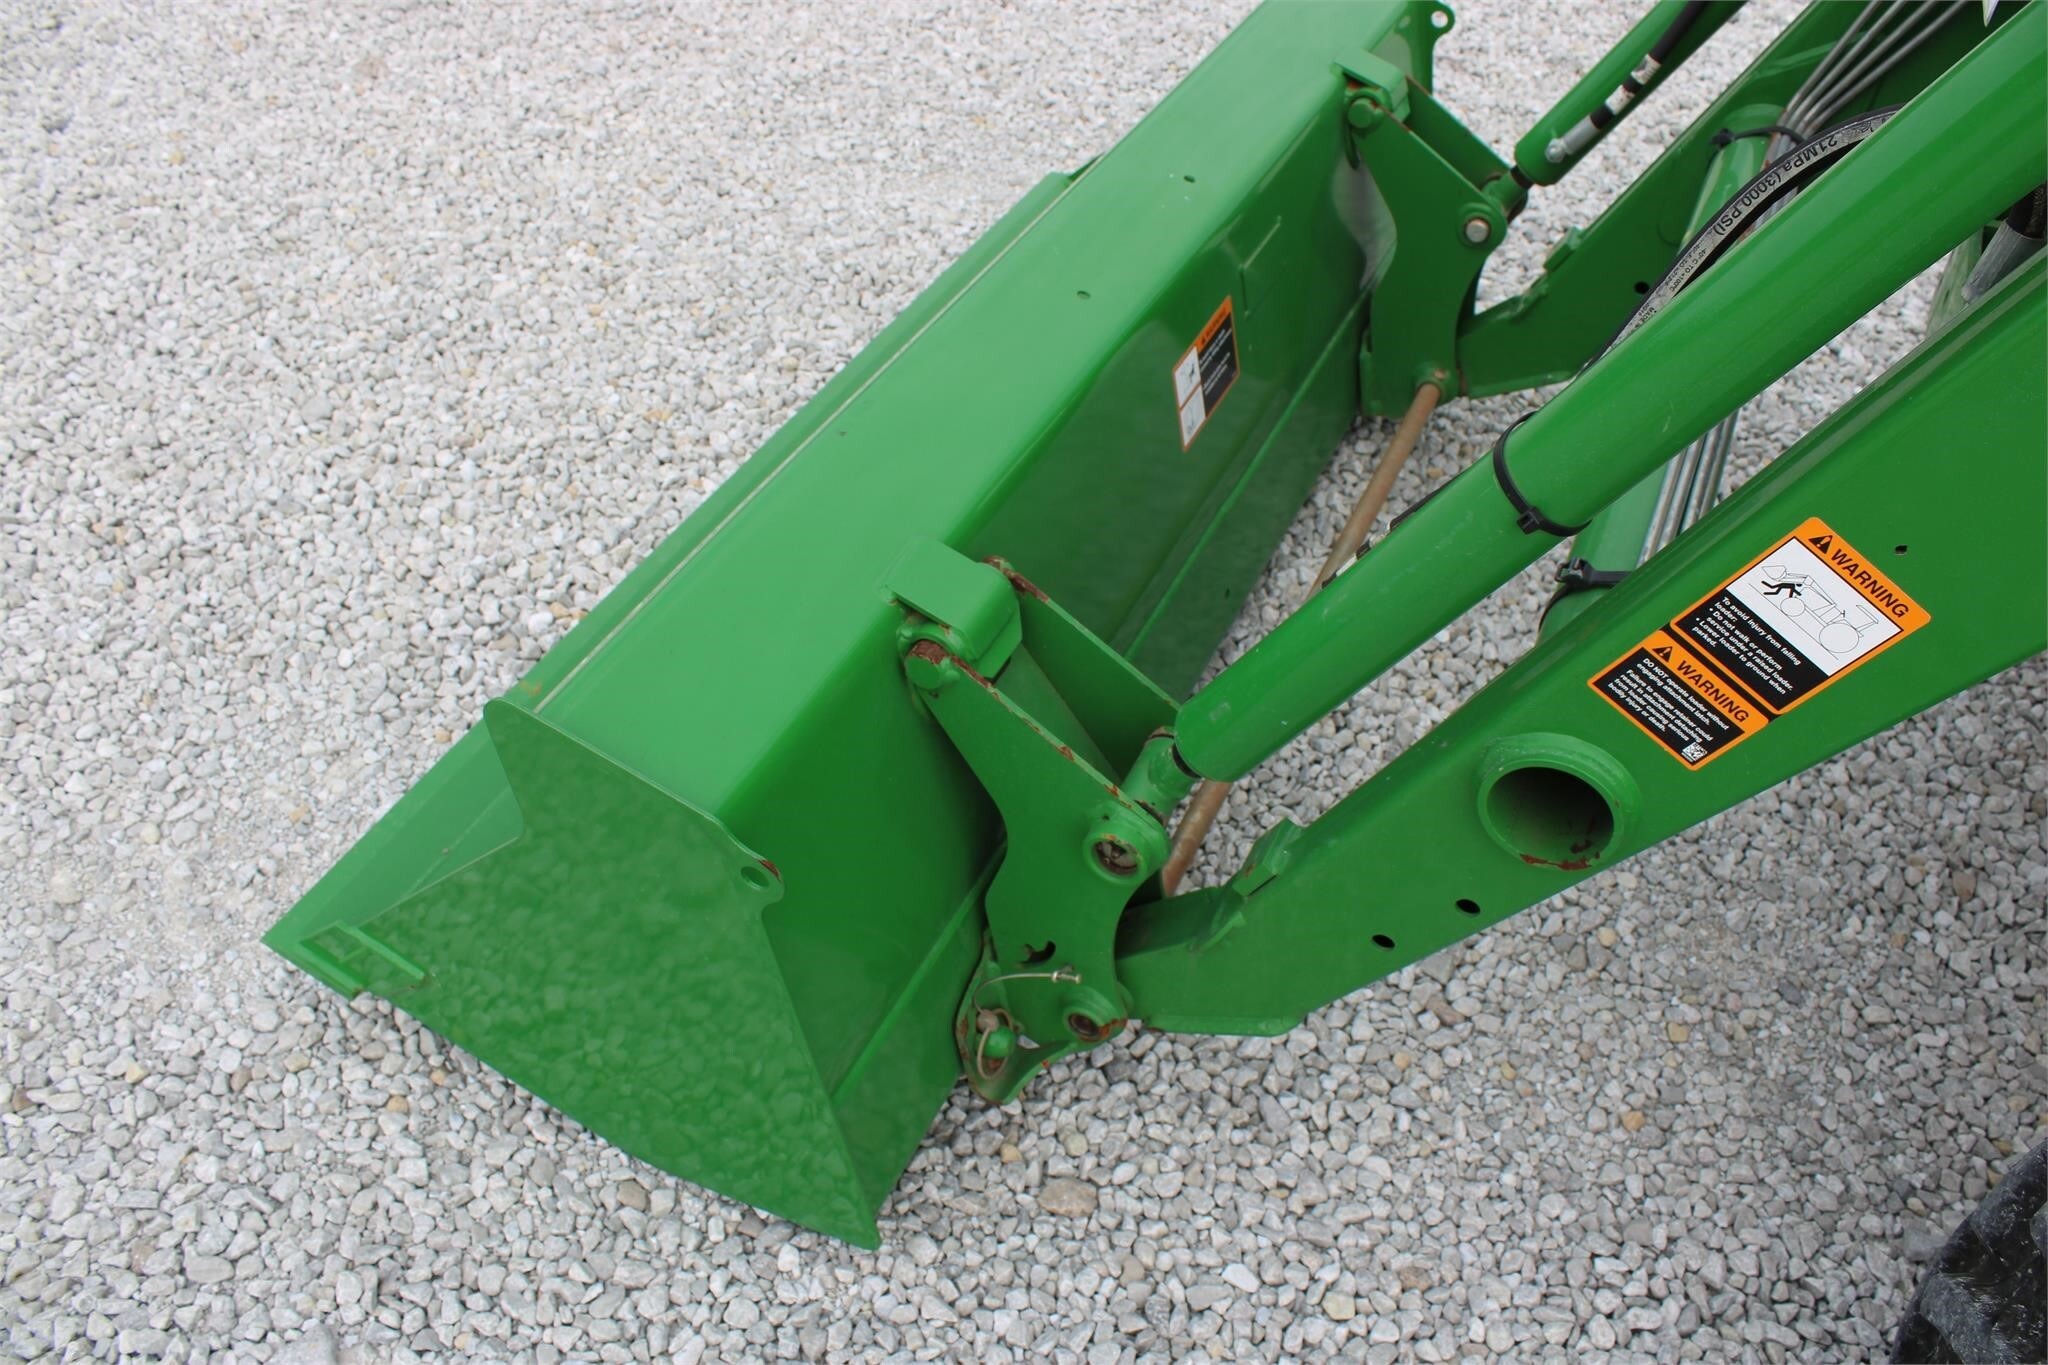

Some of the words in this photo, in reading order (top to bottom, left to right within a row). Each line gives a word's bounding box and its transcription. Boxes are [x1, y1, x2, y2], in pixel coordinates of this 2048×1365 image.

[1784, 136, 1838, 172] 21MPa
[1714, 207, 1742, 235] PSI)
[1742, 175, 1782, 207] (3000
[1715, 602, 1737, 621] loader:
[1831, 548, 1909, 619] WARNING
[1692, 626, 1717, 646] parked.
[1699, 621, 1720, 638] Lower
[1719, 637, 1740, 655] loader
[1745, 661, 1769, 680] ground
[1768, 679, 1785, 693] when
[1707, 616, 1730, 636] service
[1729, 636, 1748, 651] under
[1752, 655, 1773, 672] raised
[1773, 672, 1793, 689] loader.
[1713, 611, 1723, 619] Do
[1722, 619, 1734, 629] not
[1734, 629, 1750, 642] walk
[1755, 648, 1782, 670] perform
[1722, 597, 1731, 605] To
[1730, 604, 1748, 620] avoid
[1747, 619, 1766, 635] injury
[1766, 634, 1781, 648] from
[1780, 647, 1801, 665] falling
[1608, 683, 1626, 698] bodily
[1625, 697, 1642, 712] injury
[1648, 716, 1666, 731] death.
[1614, 678, 1629, 690] from
[1628, 690, 1647, 705] loader
[1646, 705, 1669, 724] causing
[1668, 723, 1689, 740] serious
[1620, 674, 1638, 688] result
[1643, 692, 1675, 719] attachment
[1674, 718, 1702, 742] detaching
[1626, 669, 1647, 686] Failure
[1652, 691, 1674, 710] engage
[1673, 709, 1696, 727] retainer
[1695, 726, 1712, 740] could
[1636, 663, 1663, 686] engaging
[1662, 684, 1695, 711] attachment
[1693, 711, 1711, 724] latch.
[1643, 658, 1654, 667] DO
[1652, 666, 1667, 679] NOT
[1666, 678, 1688, 697] operate
[1688, 696, 1707, 712] loader
[1706, 711, 1728, 729] without
[1677, 660, 1750, 723] WARNING
